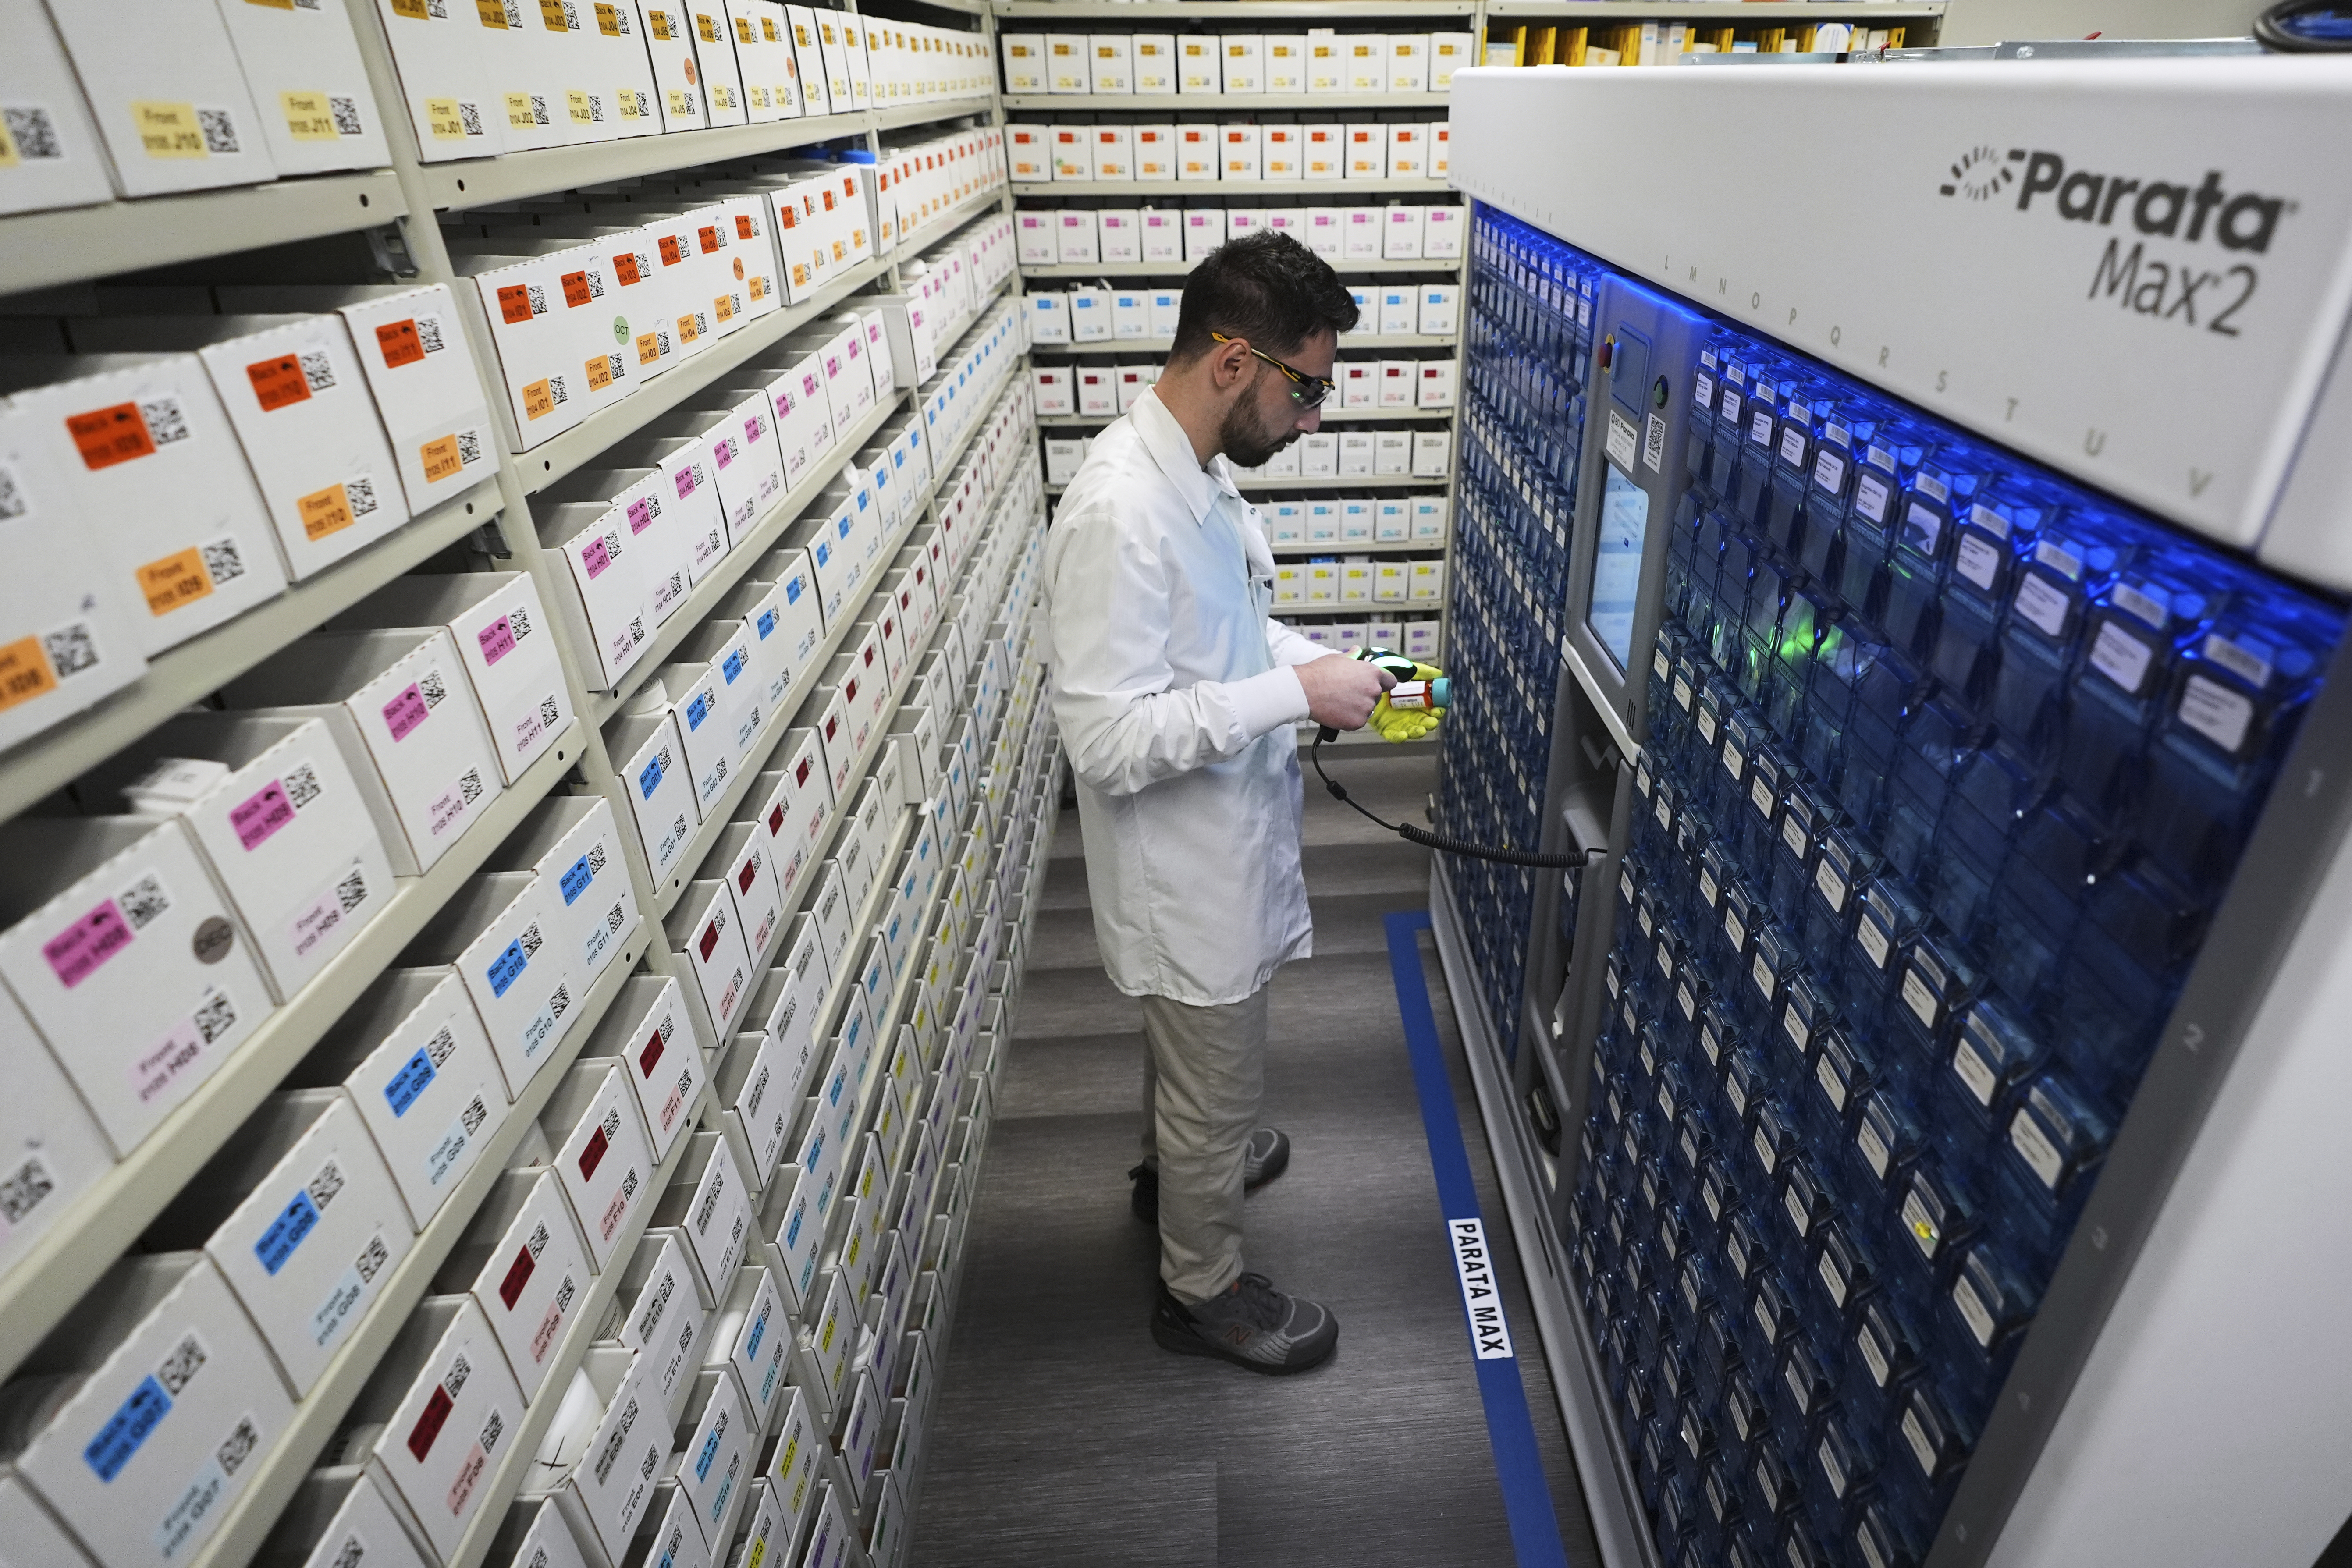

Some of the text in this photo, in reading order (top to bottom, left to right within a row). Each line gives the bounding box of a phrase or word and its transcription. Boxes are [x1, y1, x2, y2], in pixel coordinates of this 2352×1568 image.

[595, 6, 606, 15] Back
[685, 67, 694, 75] NOV
[509, 98, 524, 107] Front
[570, 95, 582, 104] Front
[579, 108, 590, 119] J03
[629, 107, 637, 115] J04
[2017, 151, 2284, 253] Parata
[733, 263, 743, 273] NOV
[615, 325, 629, 336] OCT
[680, 319, 690, 327] Front
[640, 339, 651, 347] Front
[590, 362, 602, 371] Front
[1665, 255, 2213, 499] L M N O P Q R S T U V
[527, 387, 541, 398] Front
[1621, 422, 1634, 440] Parata
[675, 474, 685, 483] Back
[685, 479, 694, 491] H03
[628, 507, 639, 517] Back
[639, 512, 650, 525] H02
[696, 540, 705, 552] Front
[583, 549, 595, 561] Back
[596, 555, 608, 568] H01
[656, 586, 665, 598] Front
[663, 592, 671, 605] H02
[614, 635, 625, 649] Front
[623, 640, 632, 655] H01
[688, 704, 697, 717] Back
[517, 717, 533, 733] Front
[529, 723, 542, 741] H11
[640, 770, 650, 785] Back
[651, 770, 660, 785] G01
[703, 774, 712, 788] Front
[710, 777, 718, 791] G02
[2304, 770, 2324, 797] 1
[660, 835, 670, 851] Front
[668, 839, 676, 853] G01
[561, 871, 576, 888] Back
[577, 872, 590, 888] G11
[587, 929, 601, 949] Front
[598, 931, 610, 950] G11
[526, 1017, 543, 1040] Front
[539, 1018, 552, 1039] G10
[2183, 1024, 2204, 1051] 2
[663, 1096, 673, 1117] Front
[671, 1097, 681, 1117] F11
[604, 1201, 616, 1225] Front
[697, 1208, 706, 1225] Back
[706, 1202, 714, 1219] E11
[1456, 1224, 1505, 1352] PARATA MAX
[652, 1304, 663, 1325] E10
[640, 1313, 651, 1333] Back
[664, 1358, 675, 1381] Front
[672, 1355, 681, 1376] E10
